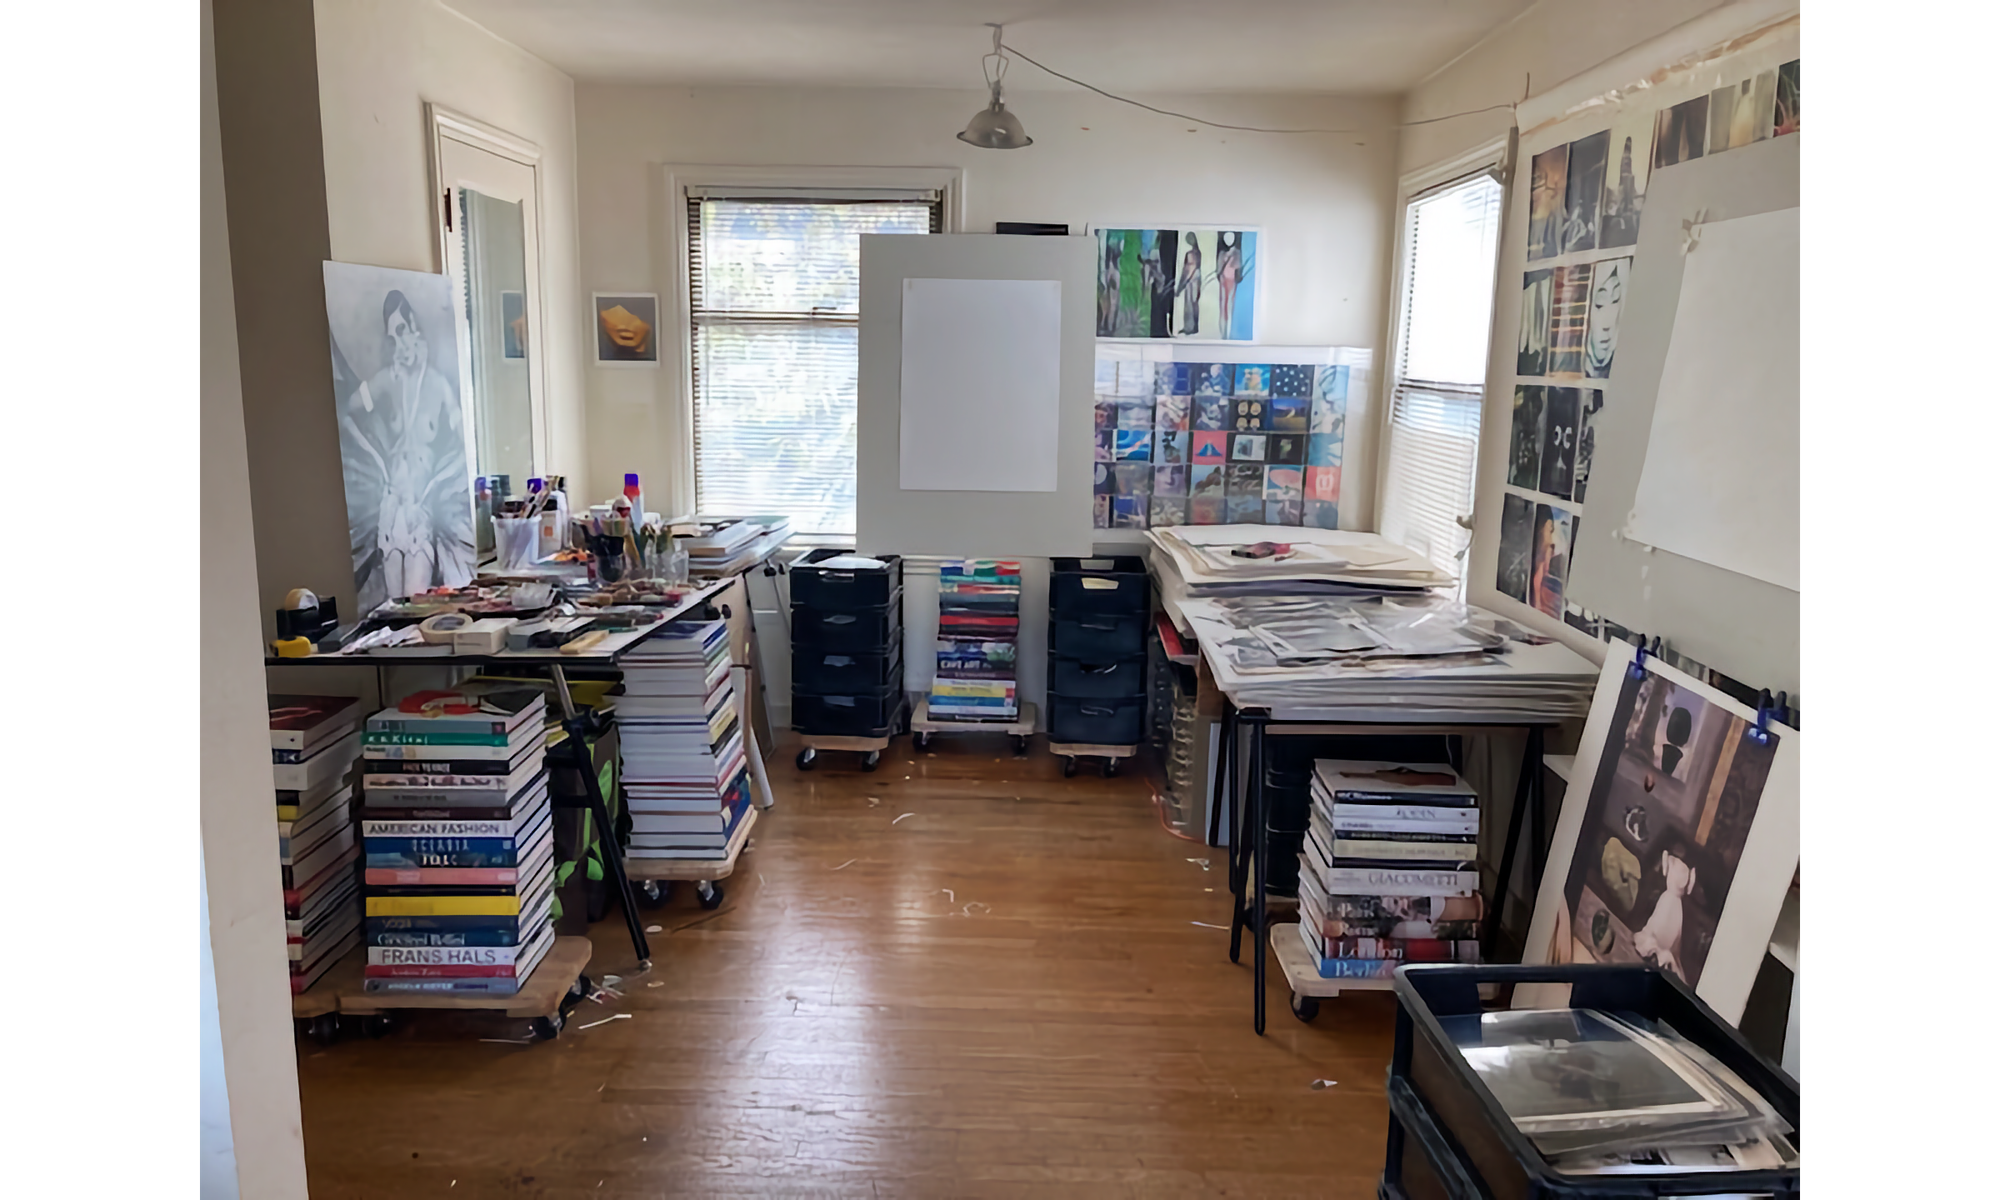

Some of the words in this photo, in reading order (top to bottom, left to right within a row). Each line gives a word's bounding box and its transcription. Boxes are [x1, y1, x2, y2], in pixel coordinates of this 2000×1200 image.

[441, 823, 499, 834] FASHION
[382, 949, 442, 964] FRANS
[448, 949, 496, 964] HALS
